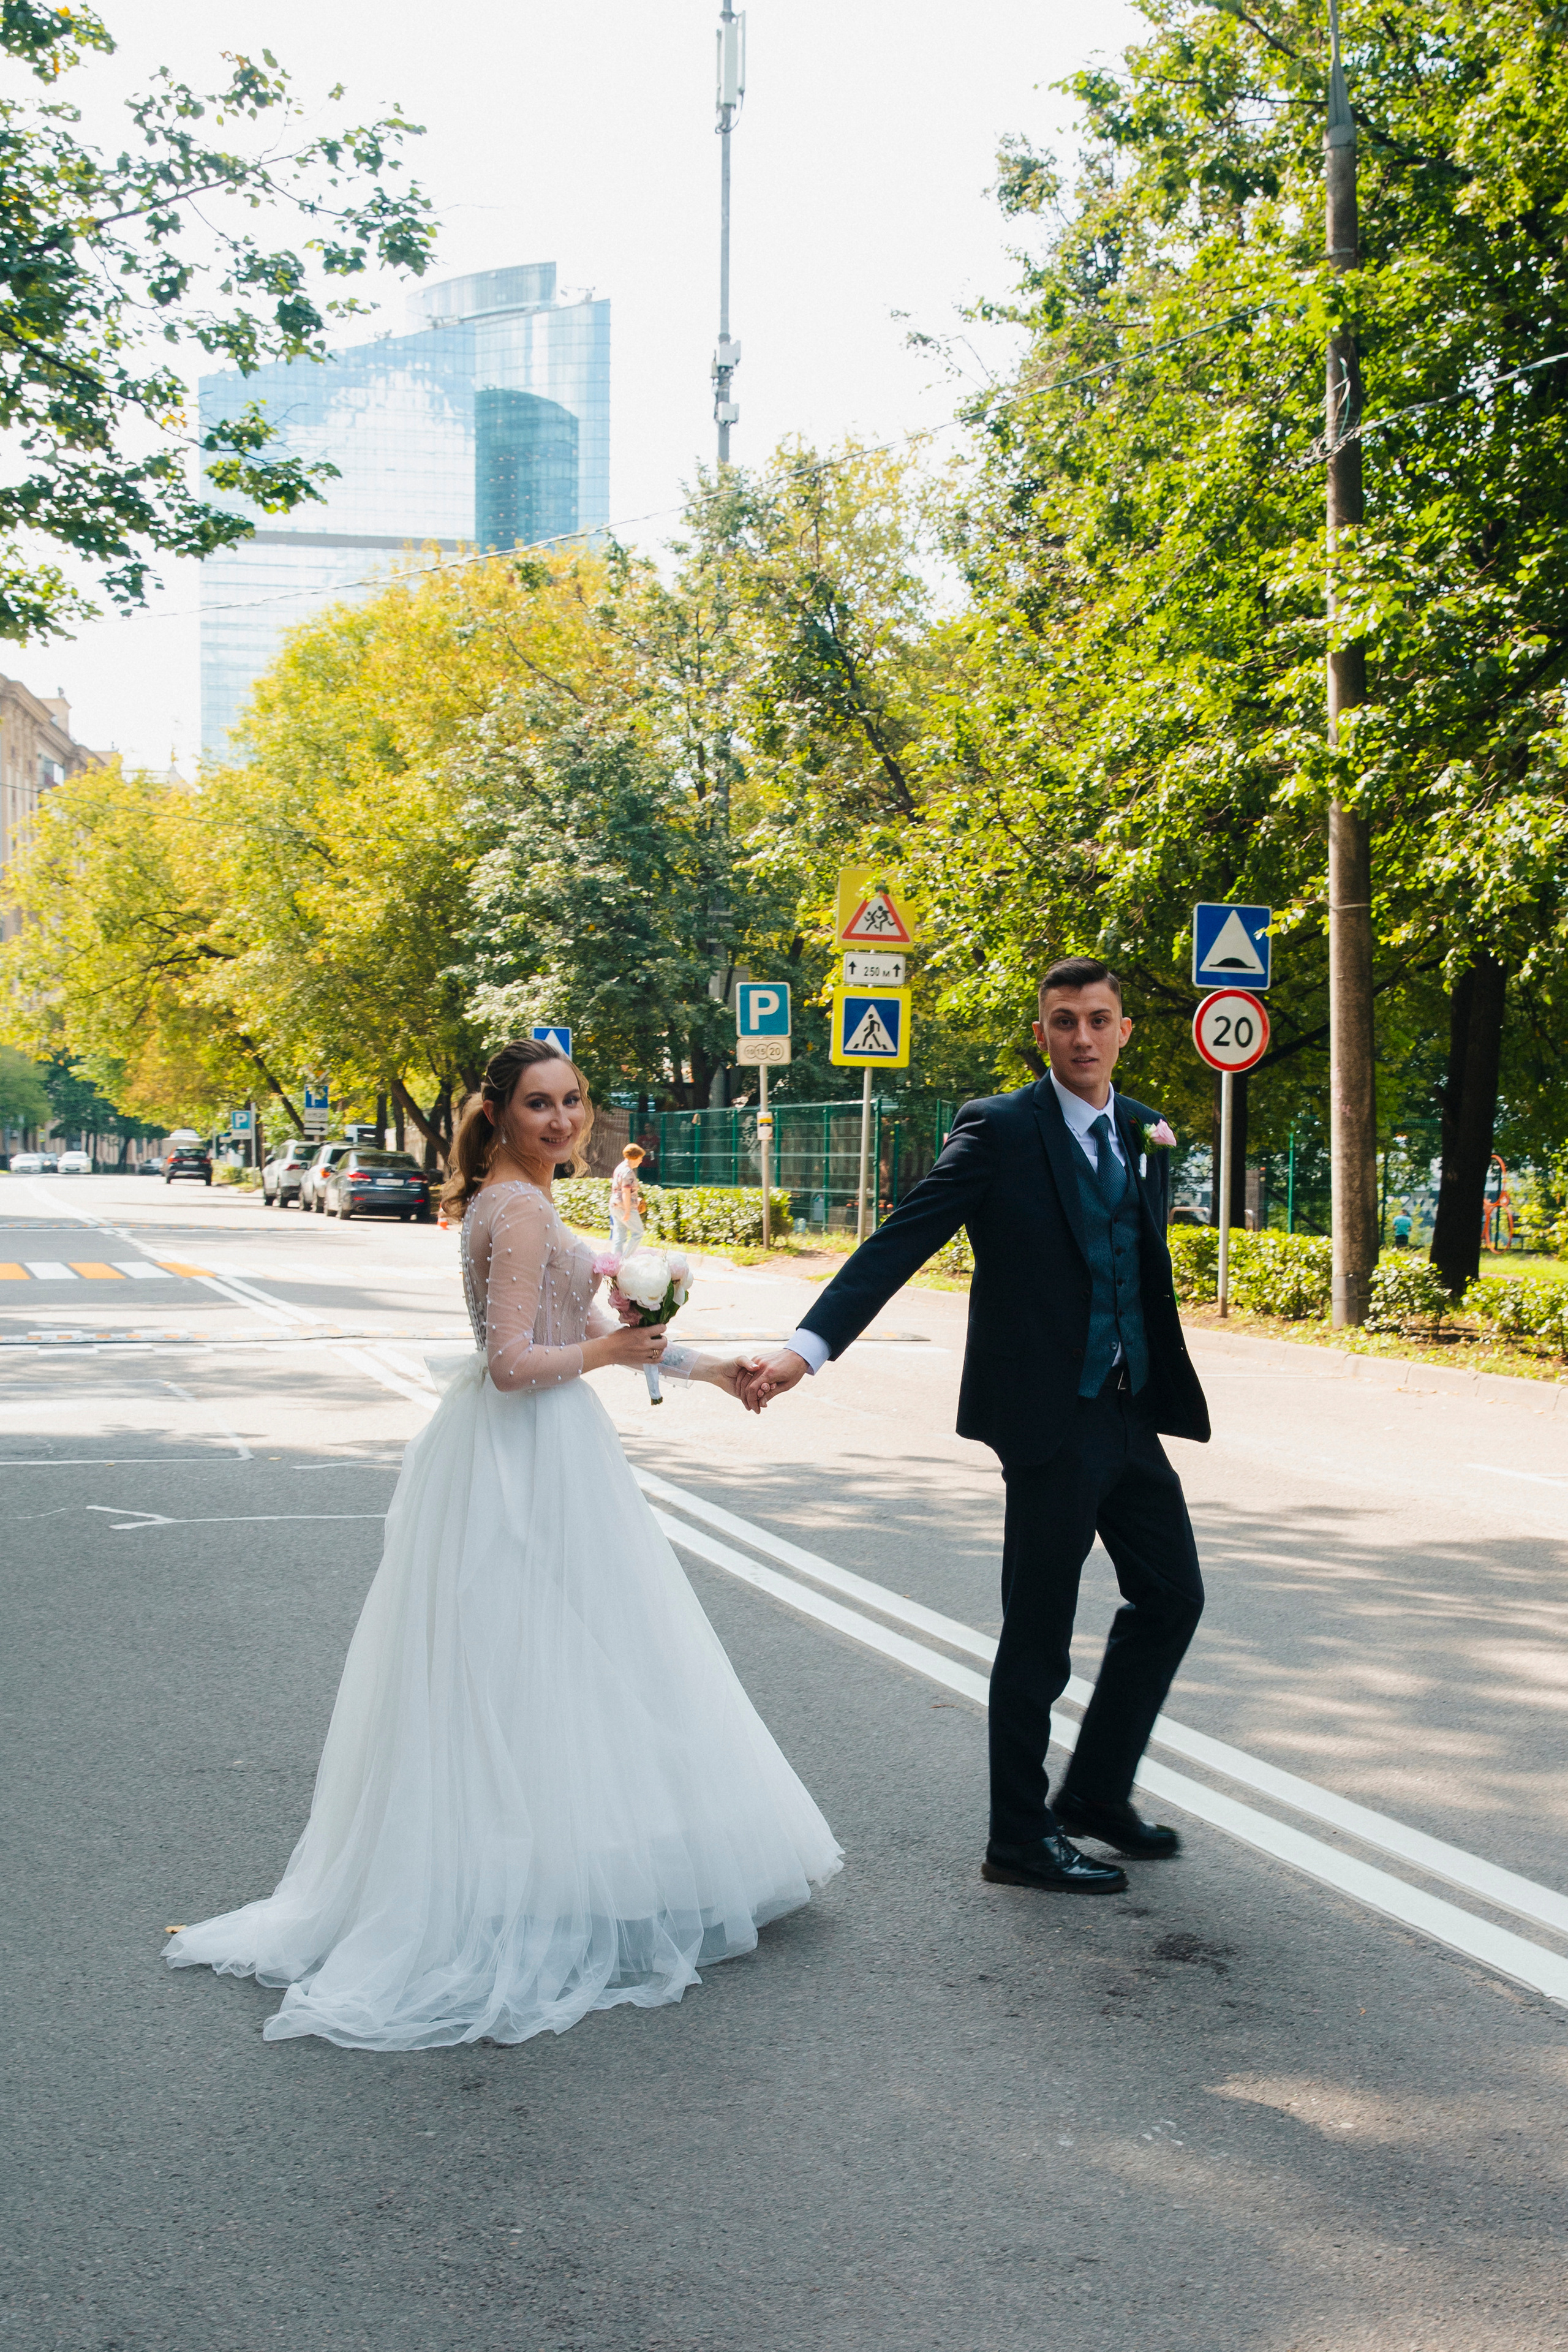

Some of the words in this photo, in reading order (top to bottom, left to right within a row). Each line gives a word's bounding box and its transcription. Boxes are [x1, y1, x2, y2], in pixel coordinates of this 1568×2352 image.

[864, 967, 880, 976] 250
[749, 990, 780, 1030] P
[1213, 1016, 1253, 1048] 20
[235, 1114, 247, 1128] P
